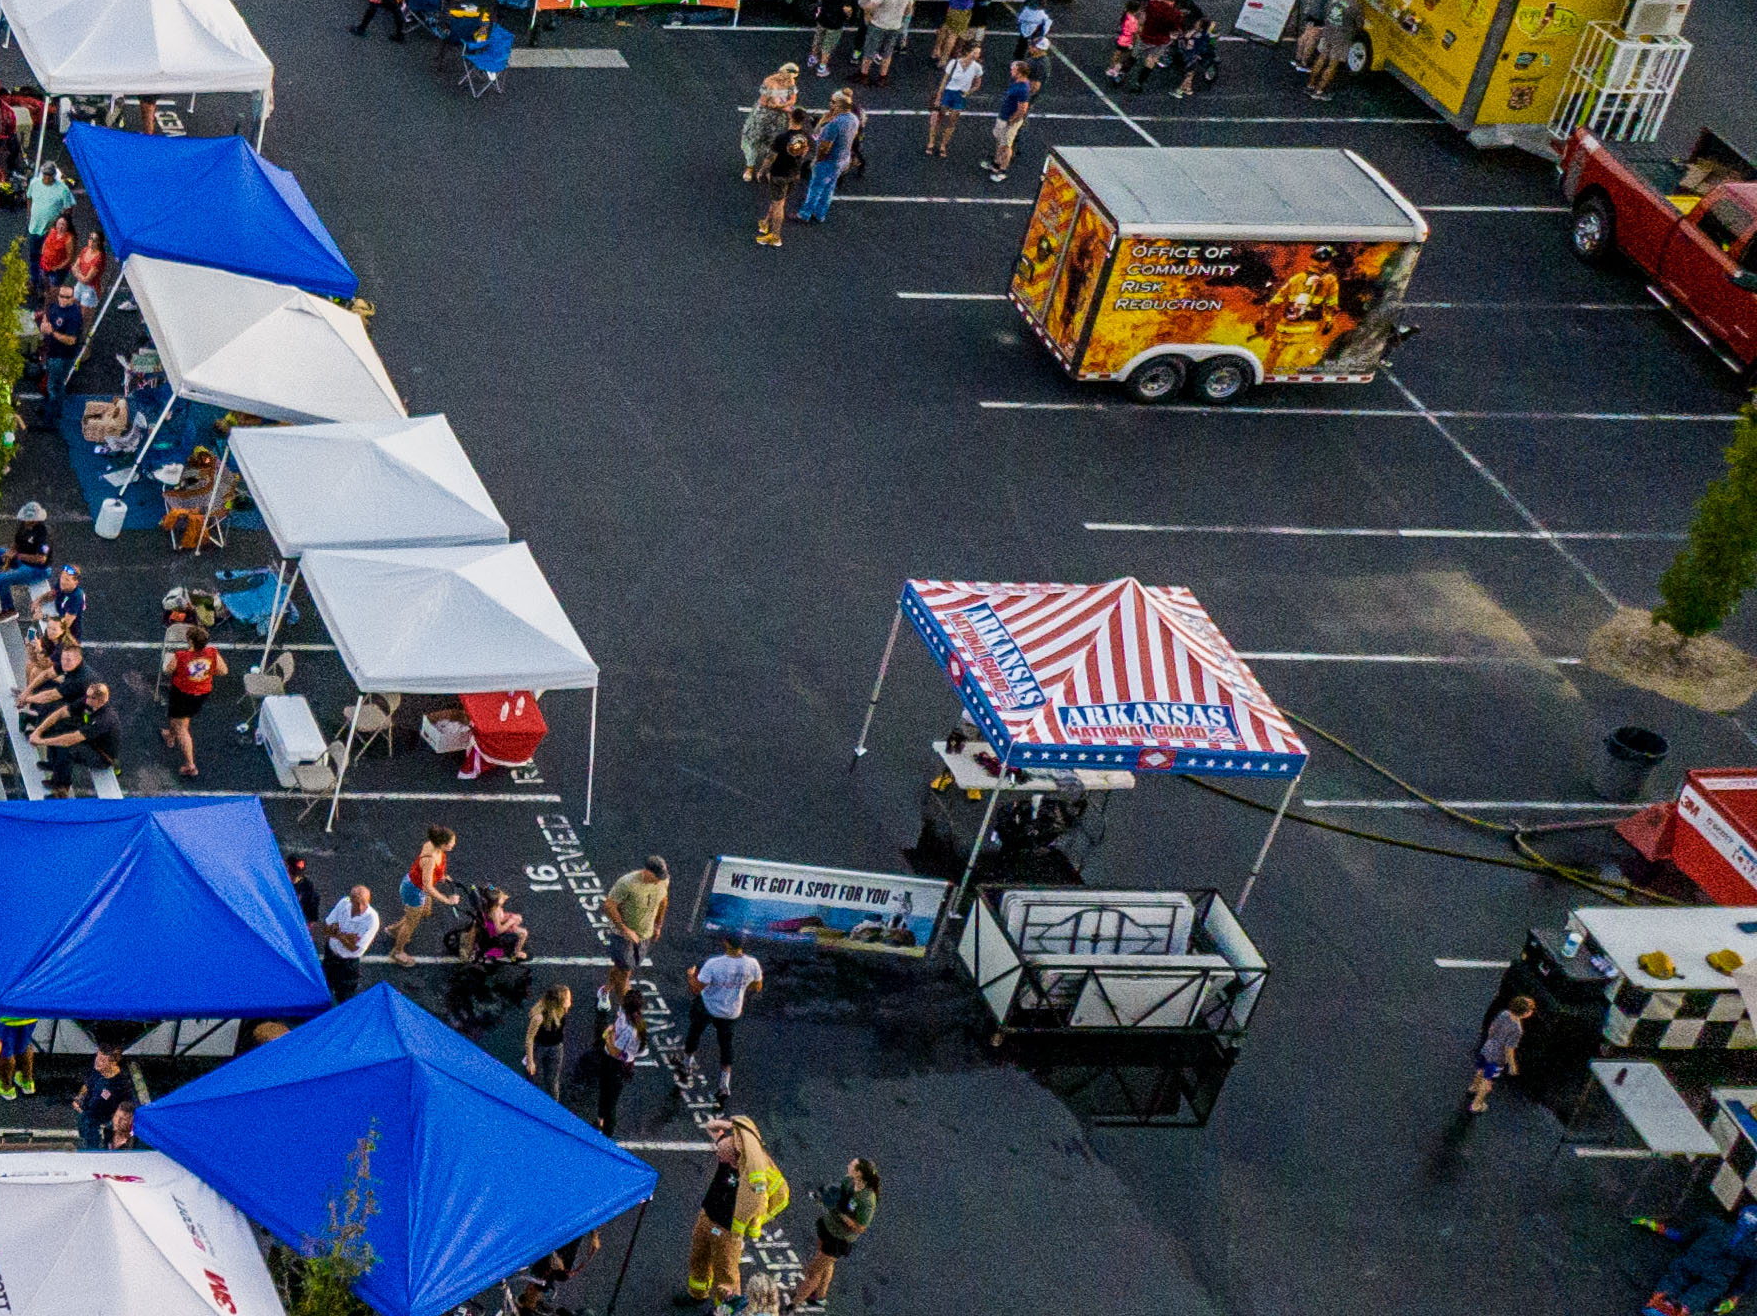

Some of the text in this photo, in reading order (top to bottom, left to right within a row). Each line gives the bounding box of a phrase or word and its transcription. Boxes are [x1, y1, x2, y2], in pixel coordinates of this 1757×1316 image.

[1132, 245, 1232, 260] OFFICE OF
[1127, 262, 1241, 277] COMMUNITY
[1121, 279, 1164, 294] RISK
[1115, 297, 1223, 312] REDUCTION
[963, 603, 1045, 709] ARKANSAS
[1062, 701, 1227, 730] ARKANSAS
[1067, 724, 1208, 740] NATIONAL GUARD
[1680, 795, 1702, 817] 3M
[525, 864, 562, 893] 16
[730, 872, 891, 906] WE'VE GOT A SPOT FOR YOU
[201, 1267, 238, 1316] 3M
